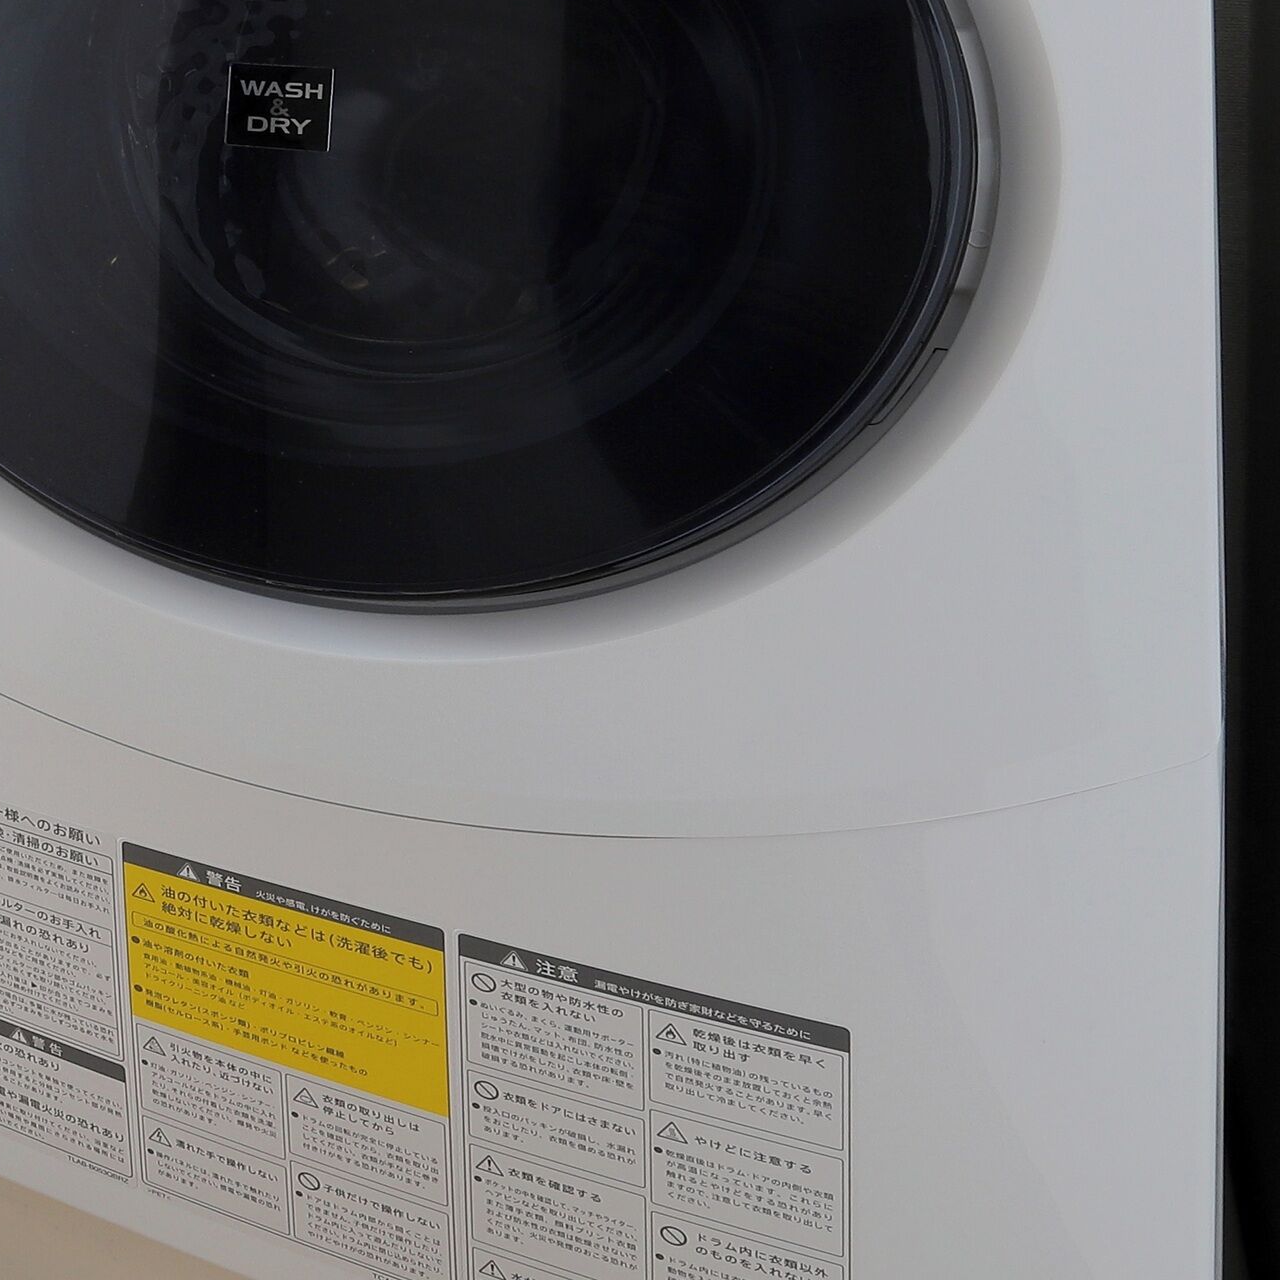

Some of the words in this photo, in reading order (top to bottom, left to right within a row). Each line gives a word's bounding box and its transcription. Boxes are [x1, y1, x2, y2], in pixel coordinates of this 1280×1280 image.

[240, 80, 323, 99] WASH
[270, 99, 289, 116] &
[247, 116, 312, 135] DRY
[206, 870, 242, 893] 警告
[161, 902, 292, 949] 絶対に乾燥しない
[536, 960, 579, 983] 注意
[500, 978, 624, 1018] 大型の物や防水性の
[501, 991, 597, 1023] 衣類を入れない
[169, 1043, 272, 1083] 引火物を本体の中に
[692, 1028, 826, 1070] 乾燥後は衣類を早く
[692, 1041, 750, 1063] 取り出す
[171, 1054, 274, 1095] 入れたり、近づけない
[322, 1094, 421, 1132] 衣類の取り出しは
[323, 1105, 395, 1136] 停止してから
[502, 1091, 637, 1136] 衣類をドアにはさまない
[694, 1135, 813, 1175] やけどに注意する
[508, 1167, 602, 1203] 衣類を確認する
[323, 1183, 441, 1230] 子供だけで操作しない
[698, 1233, 828, 1278] ドラム内に衣類以外
